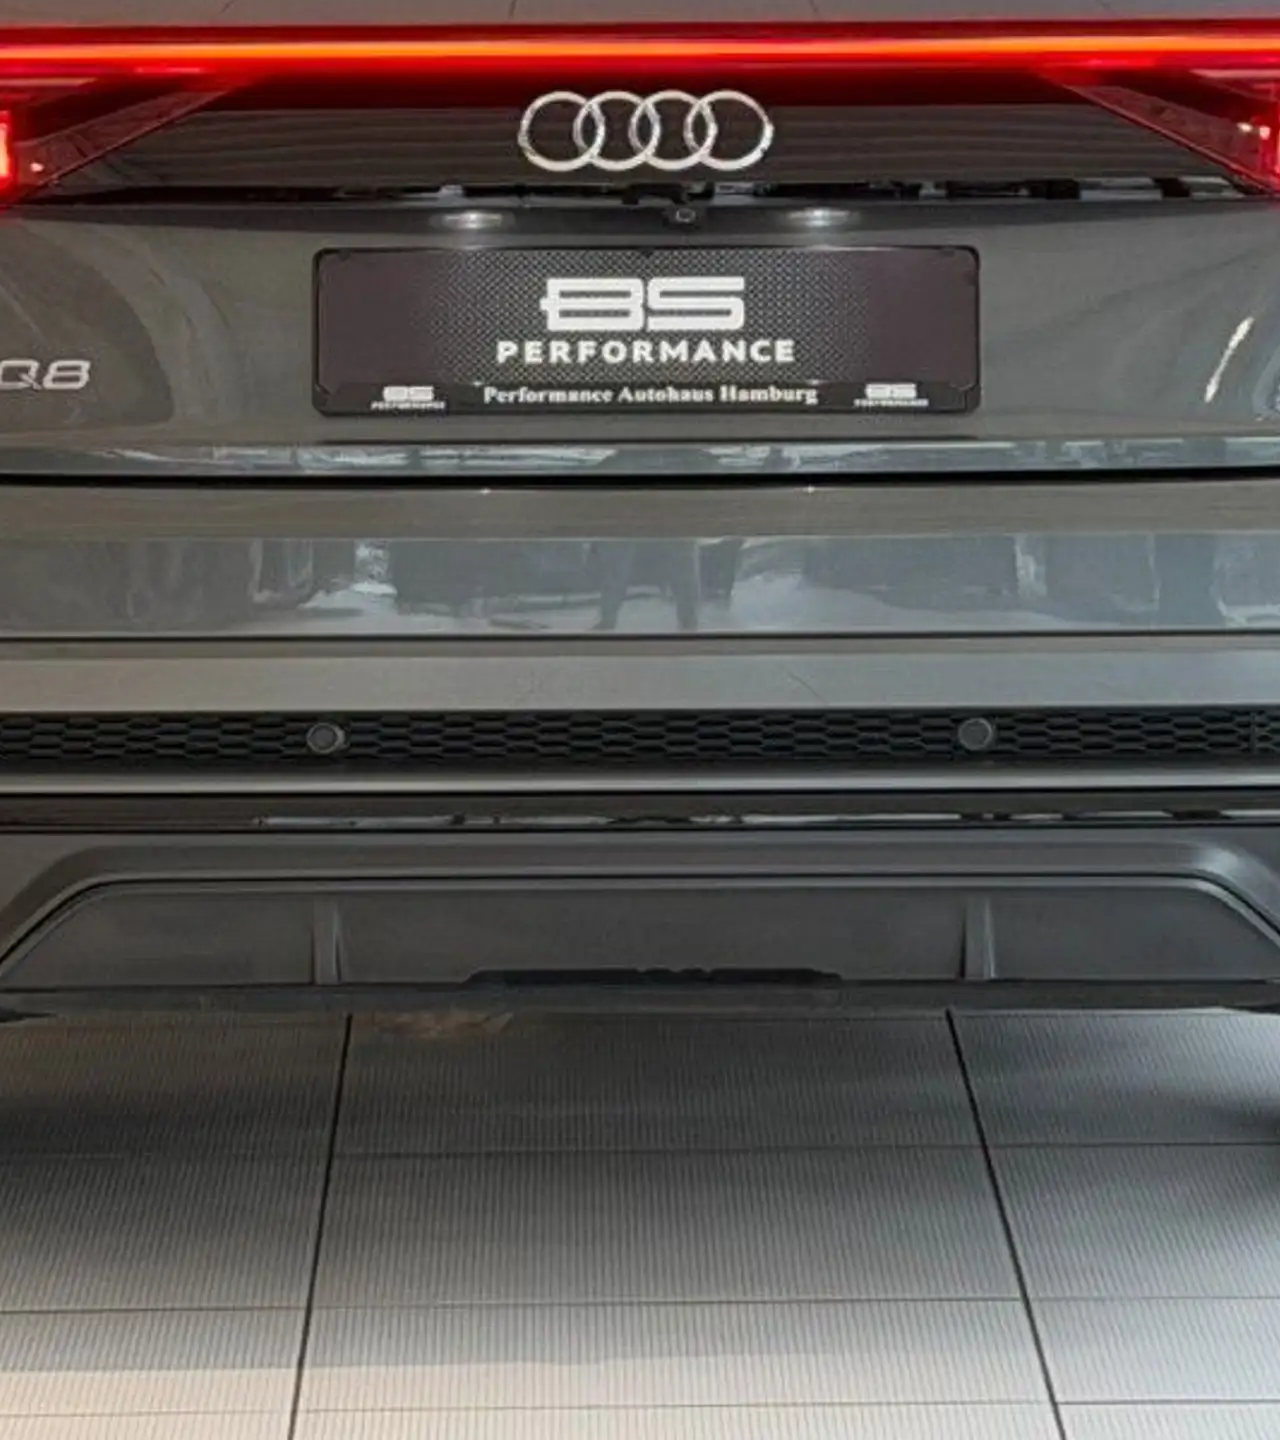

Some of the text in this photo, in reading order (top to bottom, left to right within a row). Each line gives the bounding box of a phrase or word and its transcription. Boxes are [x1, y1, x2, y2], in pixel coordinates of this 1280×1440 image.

[539, 276, 746, 333] BS
[496, 339, 795, 364] PERFORMANCE
[483, 384, 819, 405] Performance Autohaus Hamburg
